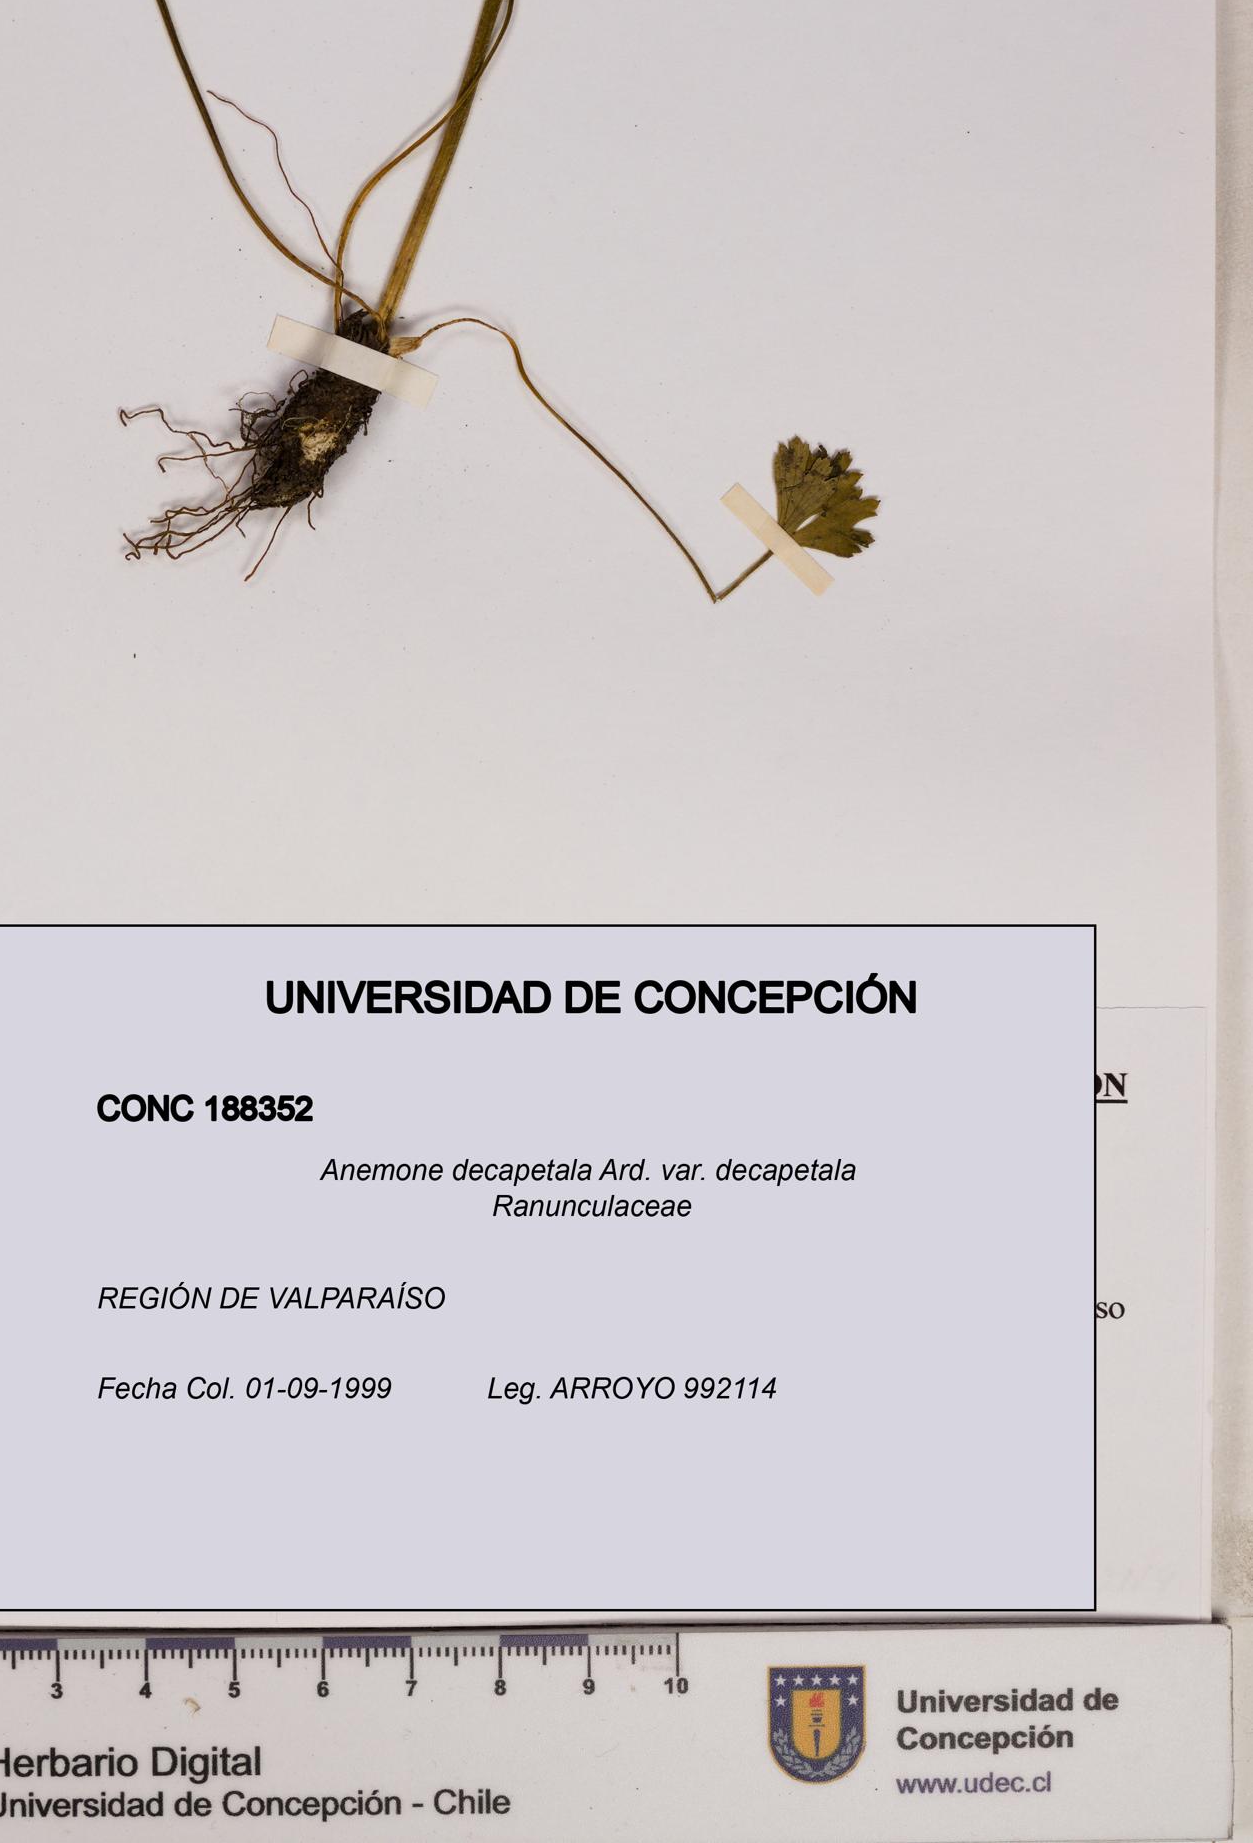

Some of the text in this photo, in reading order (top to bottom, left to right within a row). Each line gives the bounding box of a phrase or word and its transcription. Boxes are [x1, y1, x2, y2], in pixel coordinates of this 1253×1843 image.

[51, 1680, 63, 1699] 3
[139, 1680, 152, 1698] 4
[229, 1682, 240, 1698] 5
[317, 1681, 329, 1697] 6
[406, 1678, 417, 1696] 7
[495, 1680, 506, 1695] 8
[583, 1679, 595, 1695] 9
[664, 1678, 688, 1694] 10
[898, 1688, 1118, 1713] Universidad de
[897, 1725, 1073, 1754] Concepción
[152, 1746, 260, 1784] Digital
[896, 1771, 1051, 1794] www.udec.cl
[174, 1791, 212, 1817] de
[222, 1790, 401, 1822] Concepción
[434, 1789, 510, 1815] Chile
